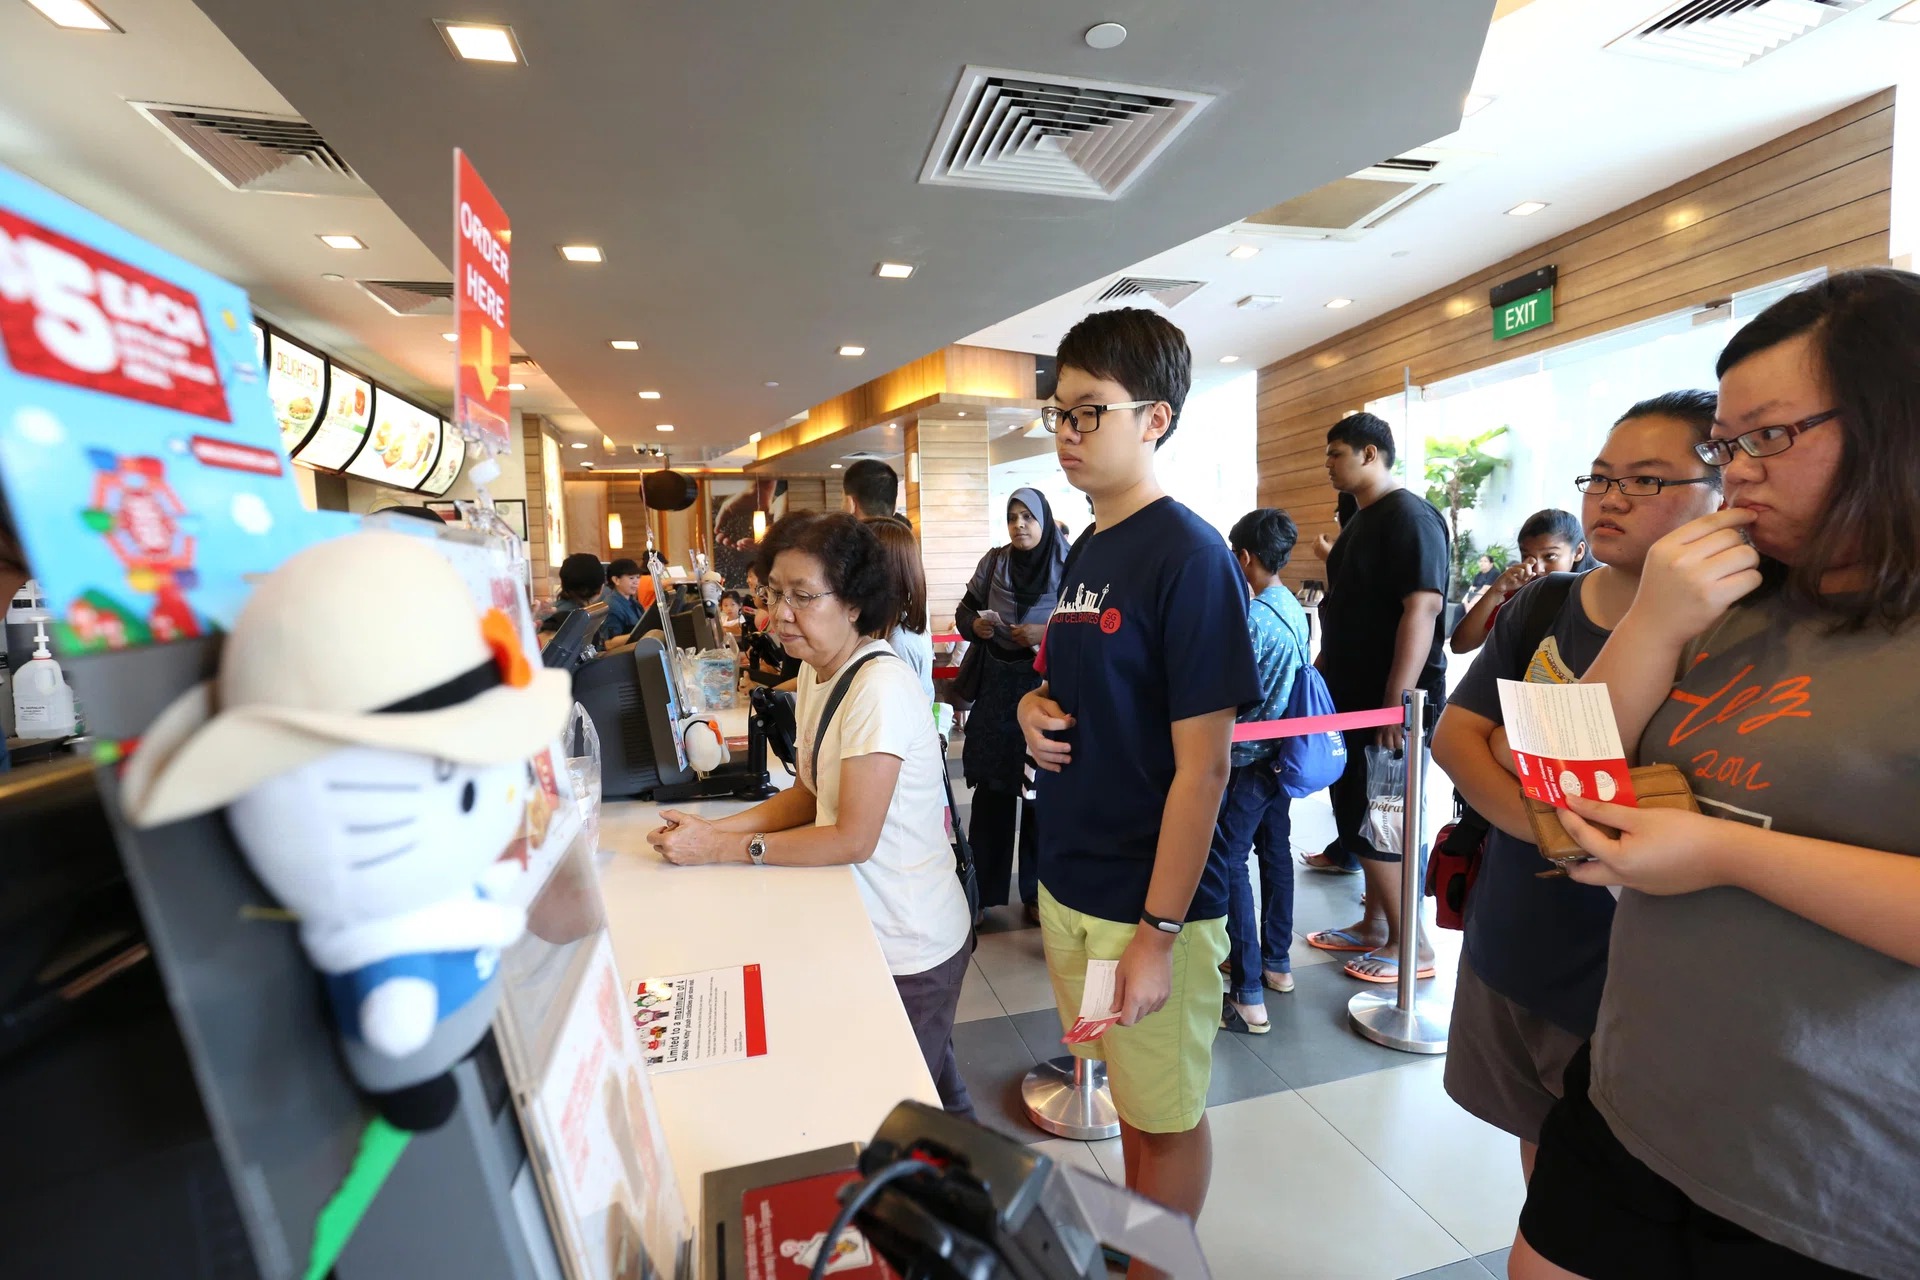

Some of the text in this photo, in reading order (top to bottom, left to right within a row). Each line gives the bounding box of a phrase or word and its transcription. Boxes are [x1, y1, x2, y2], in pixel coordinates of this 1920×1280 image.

[459, 200, 509, 284] ORDER
[466, 262, 504, 328] HERE
[1505, 299, 1538, 331] EXIT
[1103, 620, 1115, 630] 50
[1106, 612, 1116, 621] SG
[666, 1036, 680, 1063] Limited
[673, 991, 684, 1020] maximum
[682, 1039, 690, 1050] Hello
